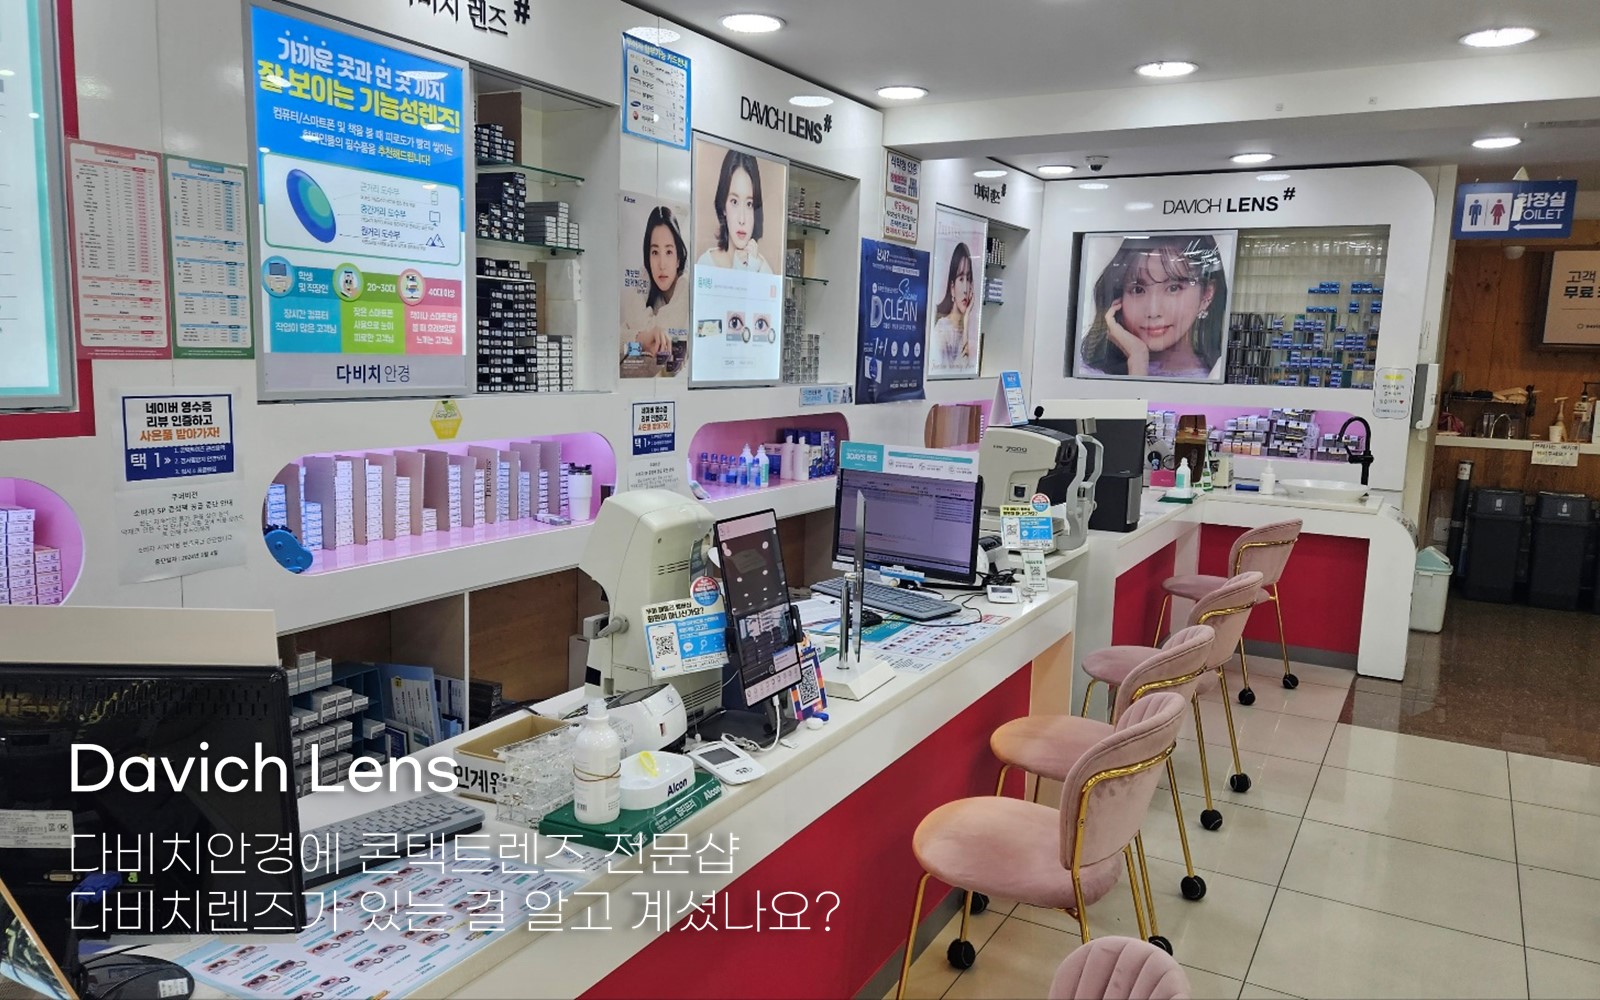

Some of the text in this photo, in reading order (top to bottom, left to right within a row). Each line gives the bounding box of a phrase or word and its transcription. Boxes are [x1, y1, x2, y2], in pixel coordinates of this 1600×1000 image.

[277, 34, 334, 74] 가까운
[337, 53, 373, 84] 곳과
[375, 63, 392, 89] 먼
[287, 68, 355, 111] 보이는
[359, 87, 461, 134] 기능성렌즈!
[272, 105, 335, 132] 컴퓨터/스마트폰
[337, 120, 346, 135] 및
[385, 131, 416, 148] 피로도가
[740, 95, 787, 133] DAVICH
[788, 117, 823, 145] LENS
[378, 145, 431, 166] 추천해드립니다!
[1162, 199, 1222, 215] DAVICH
[1226, 196, 1279, 213] LENS
[1516, 191, 1567, 208] 화장실
[1566, 270, 1597, 283] 고객
[366, 282, 397, 294] 20~30대
[1563, 286, 1594, 299] 무료
[336, 364, 411, 384] 다비치 안경
[145, 400, 213, 415] 네이버 영수증
[146, 414, 214, 428] 리뷰 인증하고
[139, 426, 220, 443] 사은품 받아가자!
[130, 452, 161, 471] 택 1
[666, 777, 689, 798] Alcon
[703, 785, 722, 802] Alcon
